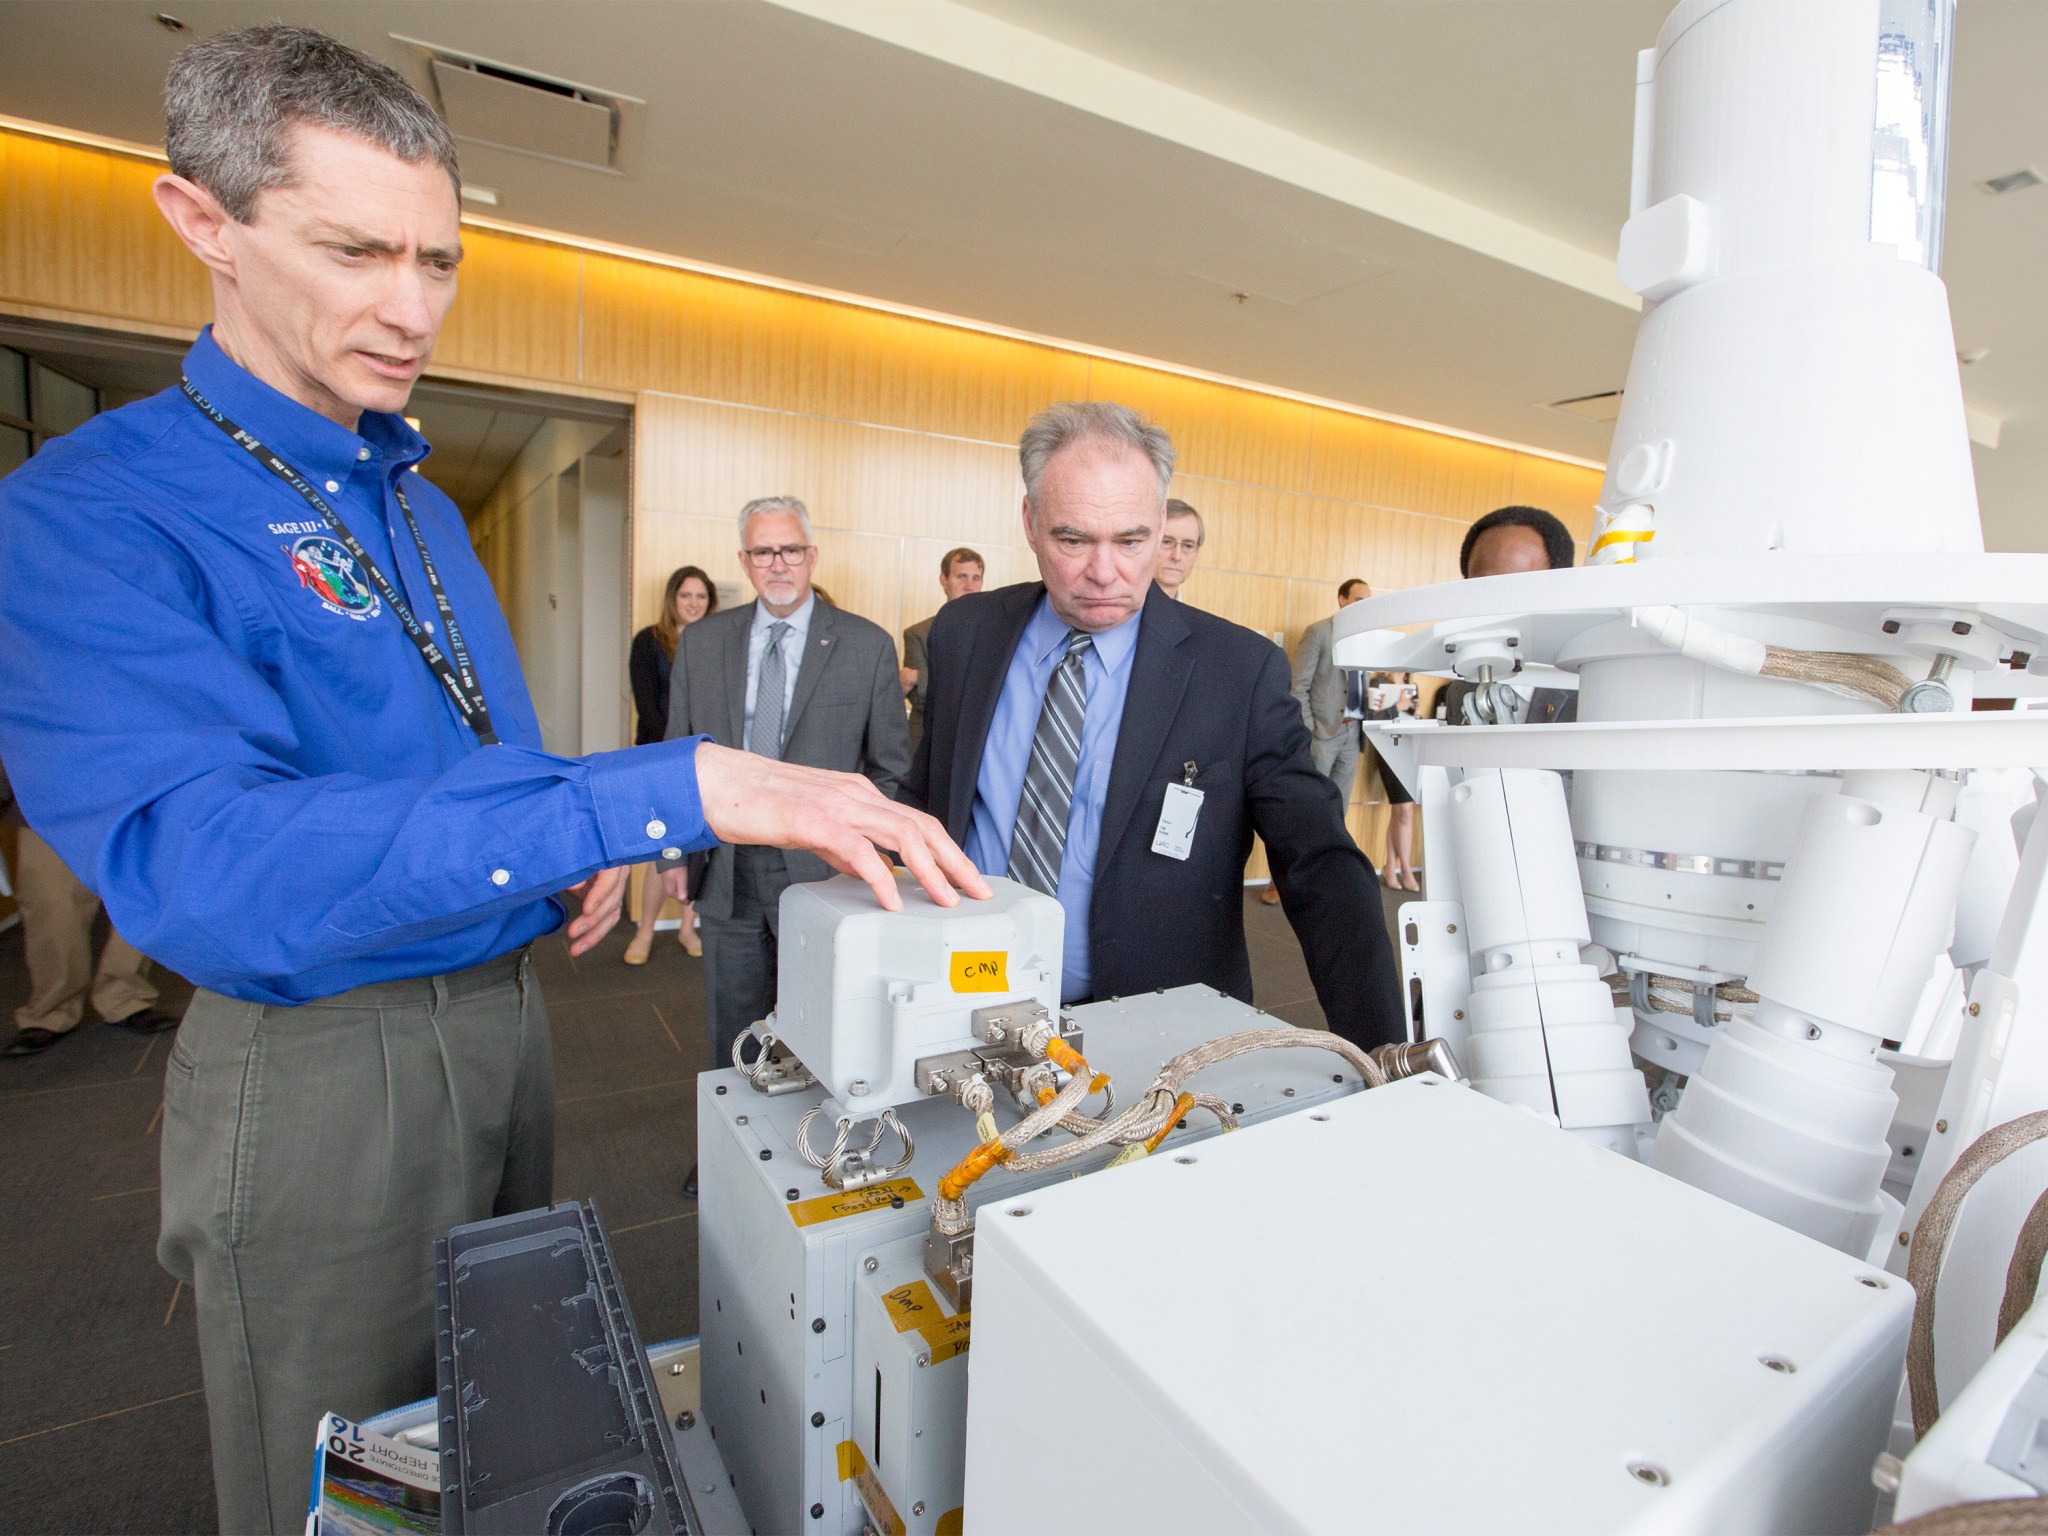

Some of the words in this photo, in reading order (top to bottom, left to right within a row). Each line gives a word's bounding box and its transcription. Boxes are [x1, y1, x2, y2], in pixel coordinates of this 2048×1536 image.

[184, 381, 197, 396] III
[194, 394, 224, 422] SAGE
[270, 457, 284, 471] ISS
[290, 478, 311, 494] III
[308, 494, 340, 526] SAGE
[268, 523, 302, 534] SAGE
[299, 520, 318, 532] III
[408, 519, 426, 548] SAGE
[421, 550, 432, 564] III
[384, 587, 400, 604] III
[396, 604, 421, 635] SAGE
[446, 619, 465, 650] SAGE
[456, 652, 470, 667] III
[463, 676, 474, 689] ISS
[331, 1416, 364, 1442] 16
[330, 1435, 366, 1463] 20
[370, 1444, 428, 1470] REPORT
[369, 1454, 429, 1480] DIRECTORATE
